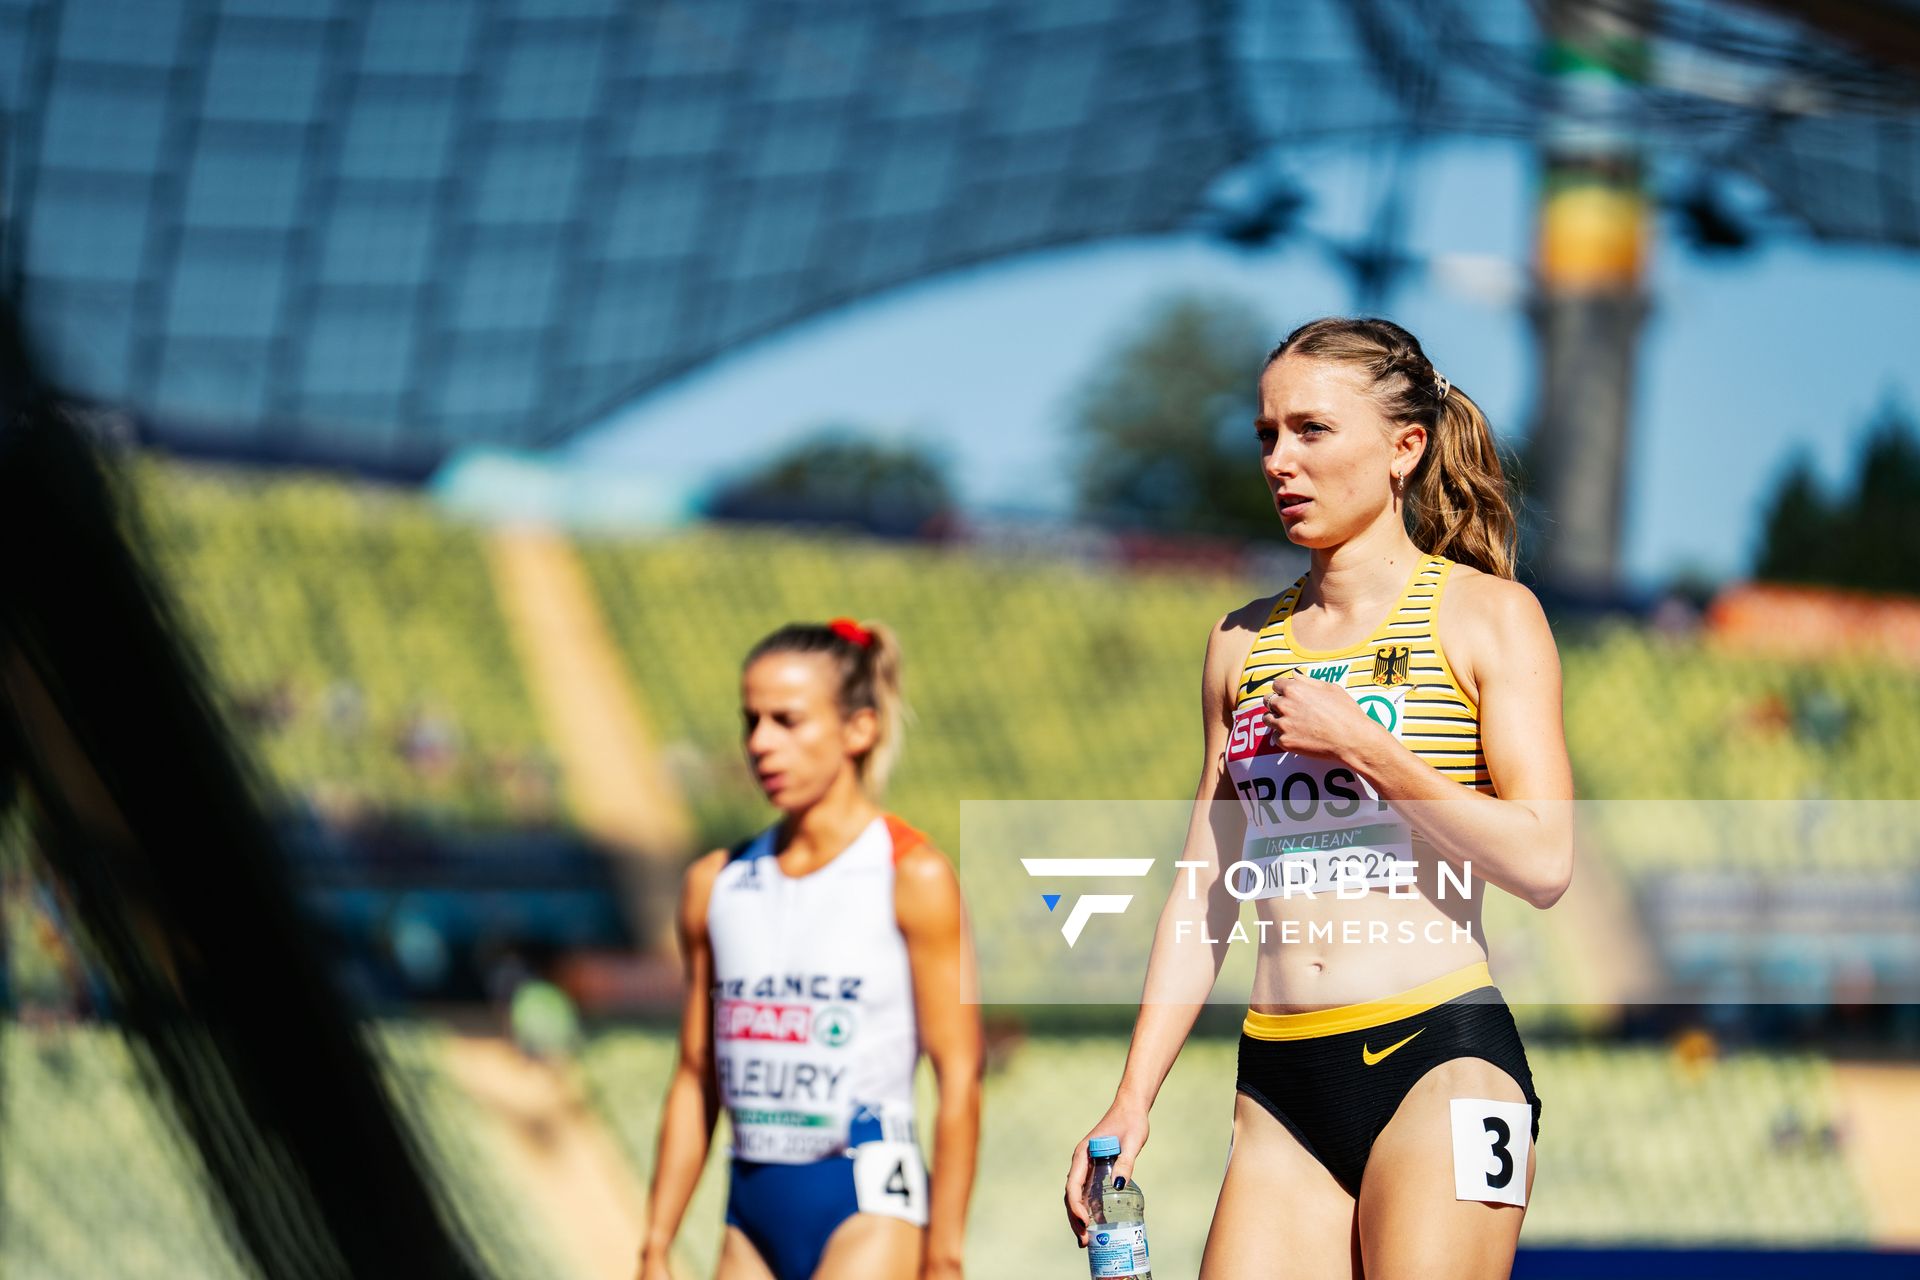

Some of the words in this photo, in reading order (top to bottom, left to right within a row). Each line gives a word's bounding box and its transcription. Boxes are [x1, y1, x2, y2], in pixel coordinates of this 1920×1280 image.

[1328, 852, 1398, 882] 2022
[1483, 1116, 1514, 1189] 3
[885, 1157, 911, 1208] 4
